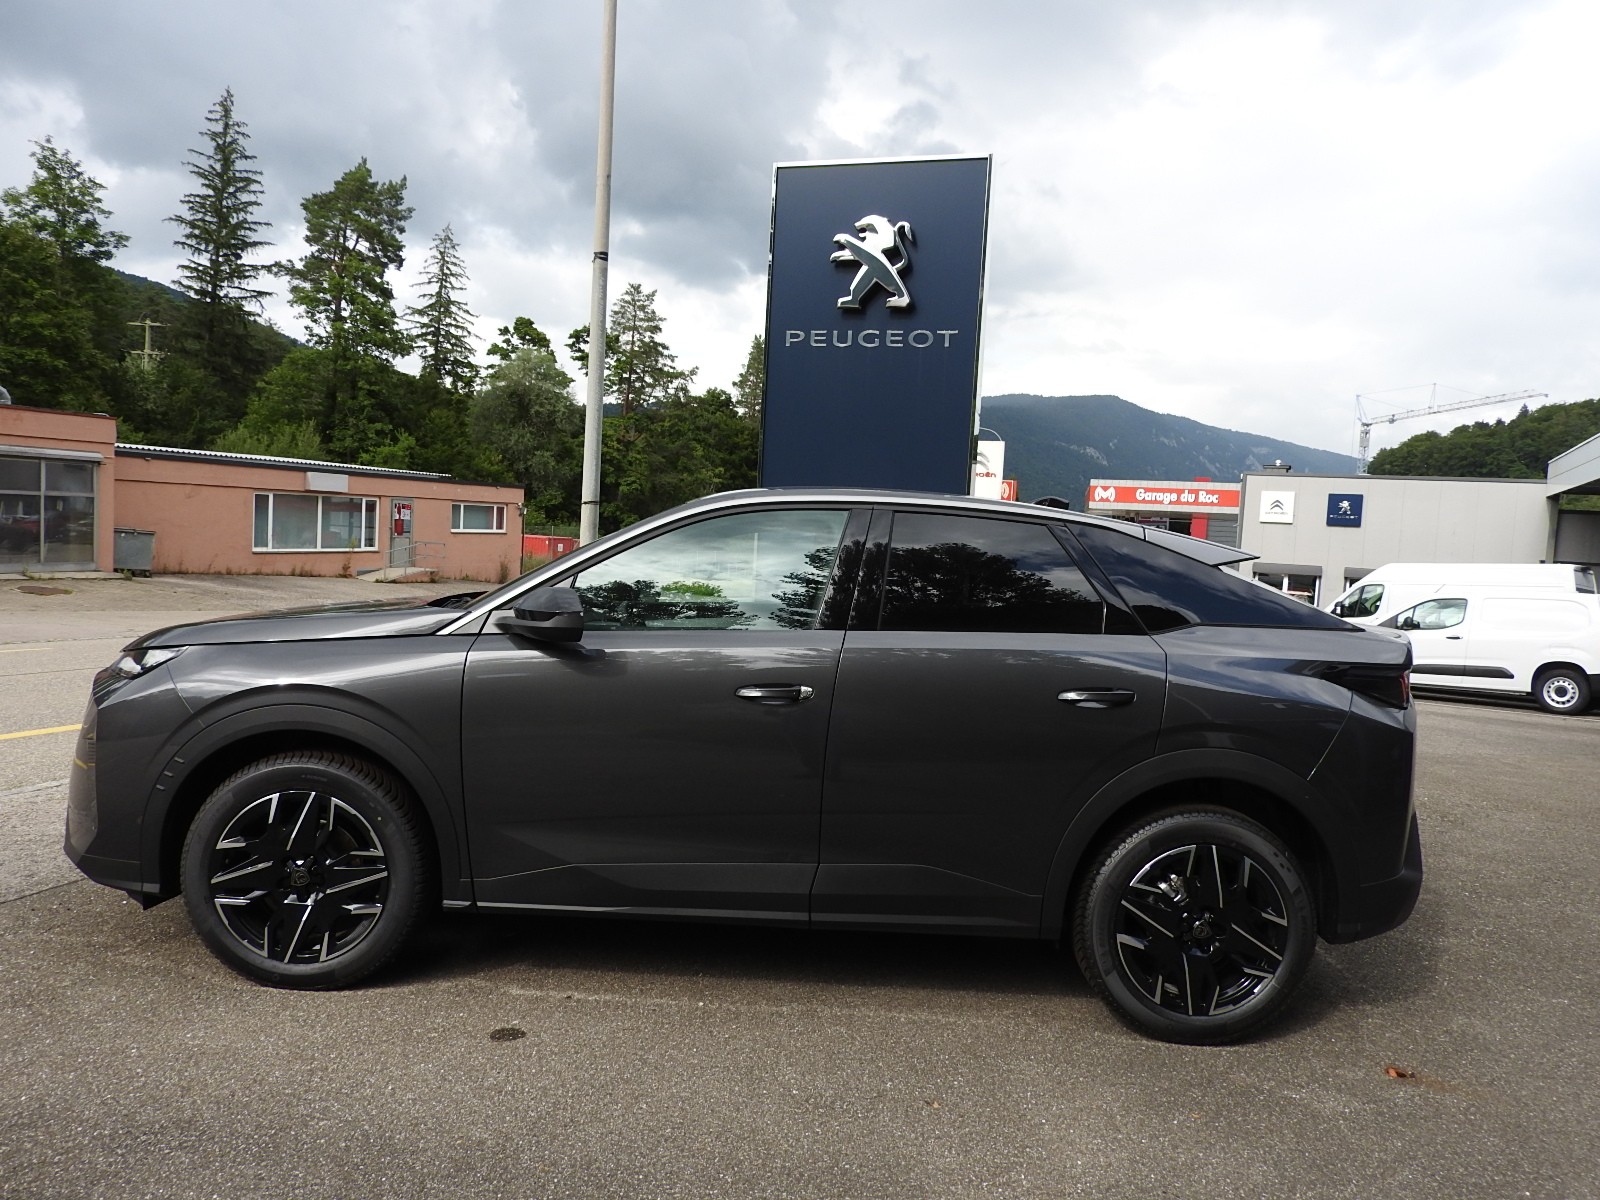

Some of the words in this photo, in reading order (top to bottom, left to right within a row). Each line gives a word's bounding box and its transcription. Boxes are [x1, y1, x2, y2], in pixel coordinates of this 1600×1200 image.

[785, 330, 959, 348] PEUGEOT
[1135, 488, 1178, 504] Garage
[1180, 489, 1196, 503] du
[1198, 490, 1219, 504] Roc
